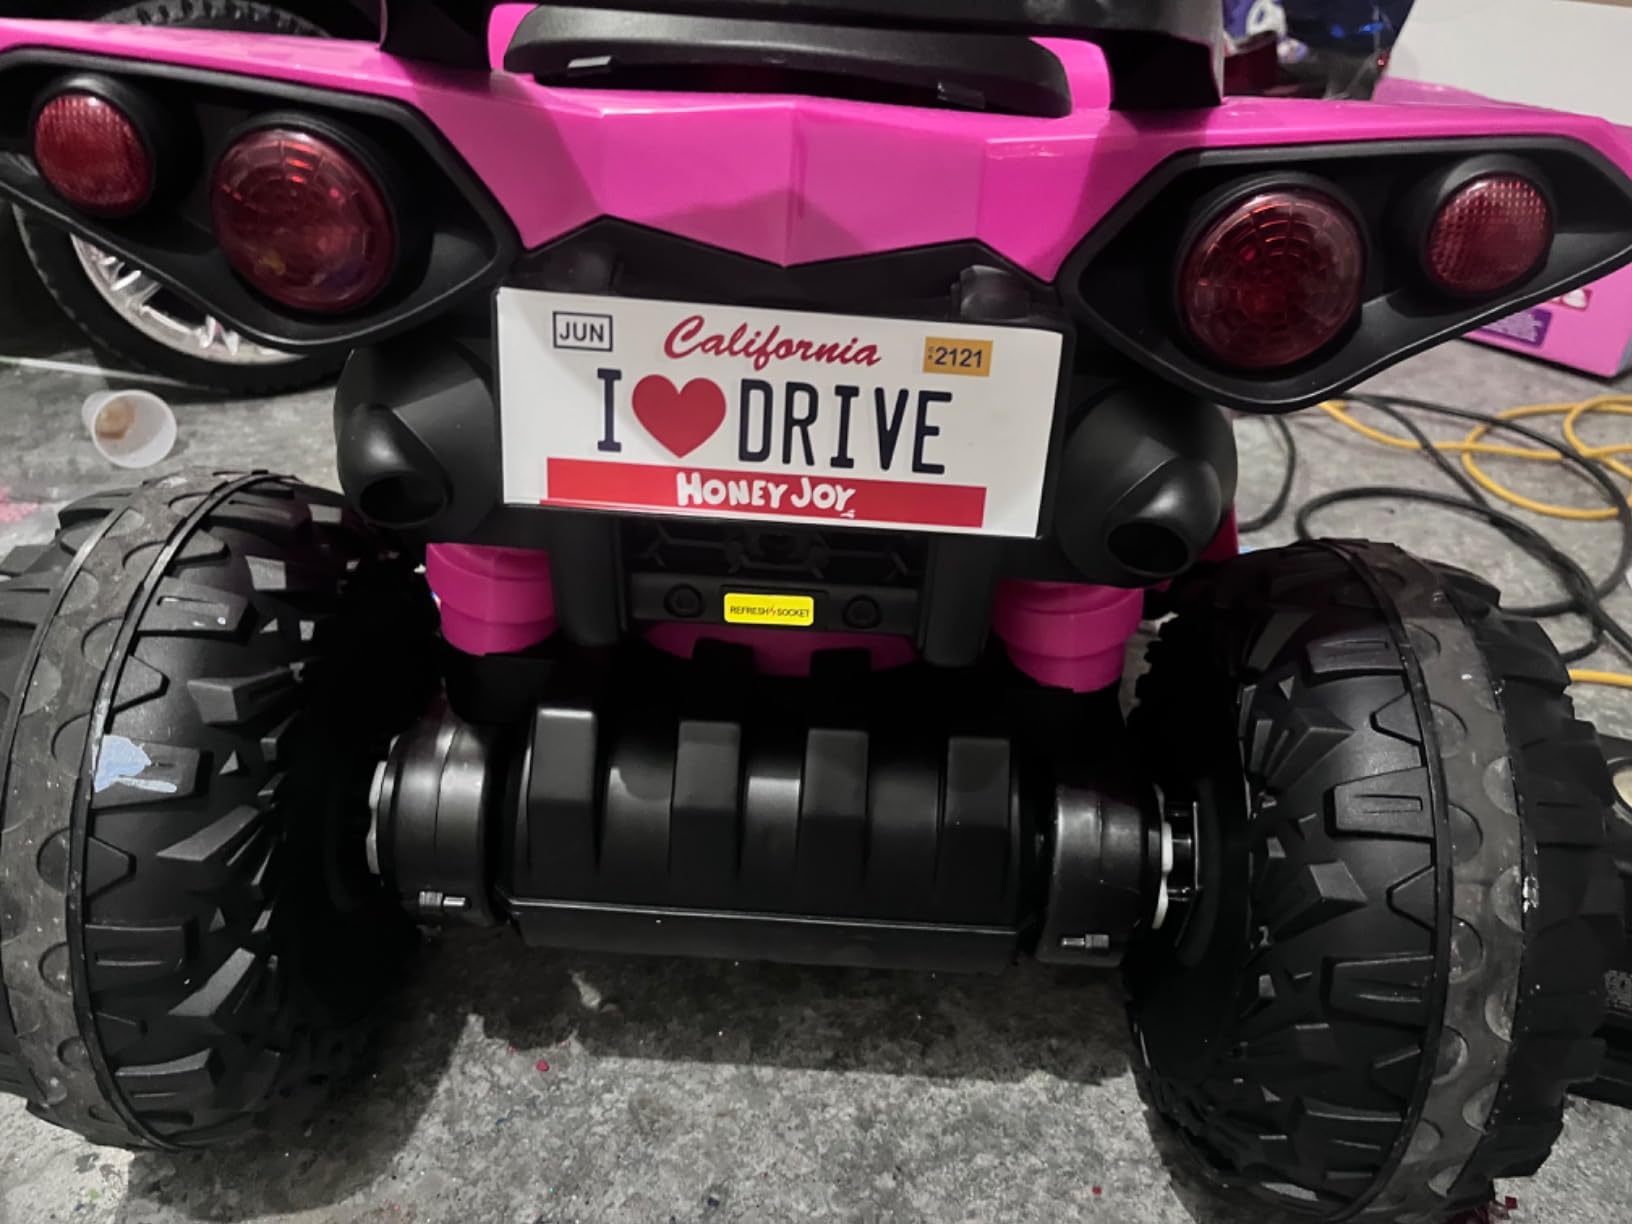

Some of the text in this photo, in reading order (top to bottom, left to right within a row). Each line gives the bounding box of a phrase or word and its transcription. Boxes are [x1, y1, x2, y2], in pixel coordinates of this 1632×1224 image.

[559, 321, 605, 345] JUN
[663, 314, 882, 371] California
[934, 345, 983, 368] 2121
[596, 368, 953, 475] I DRIVE
[790, 476, 856, 512] JOY
